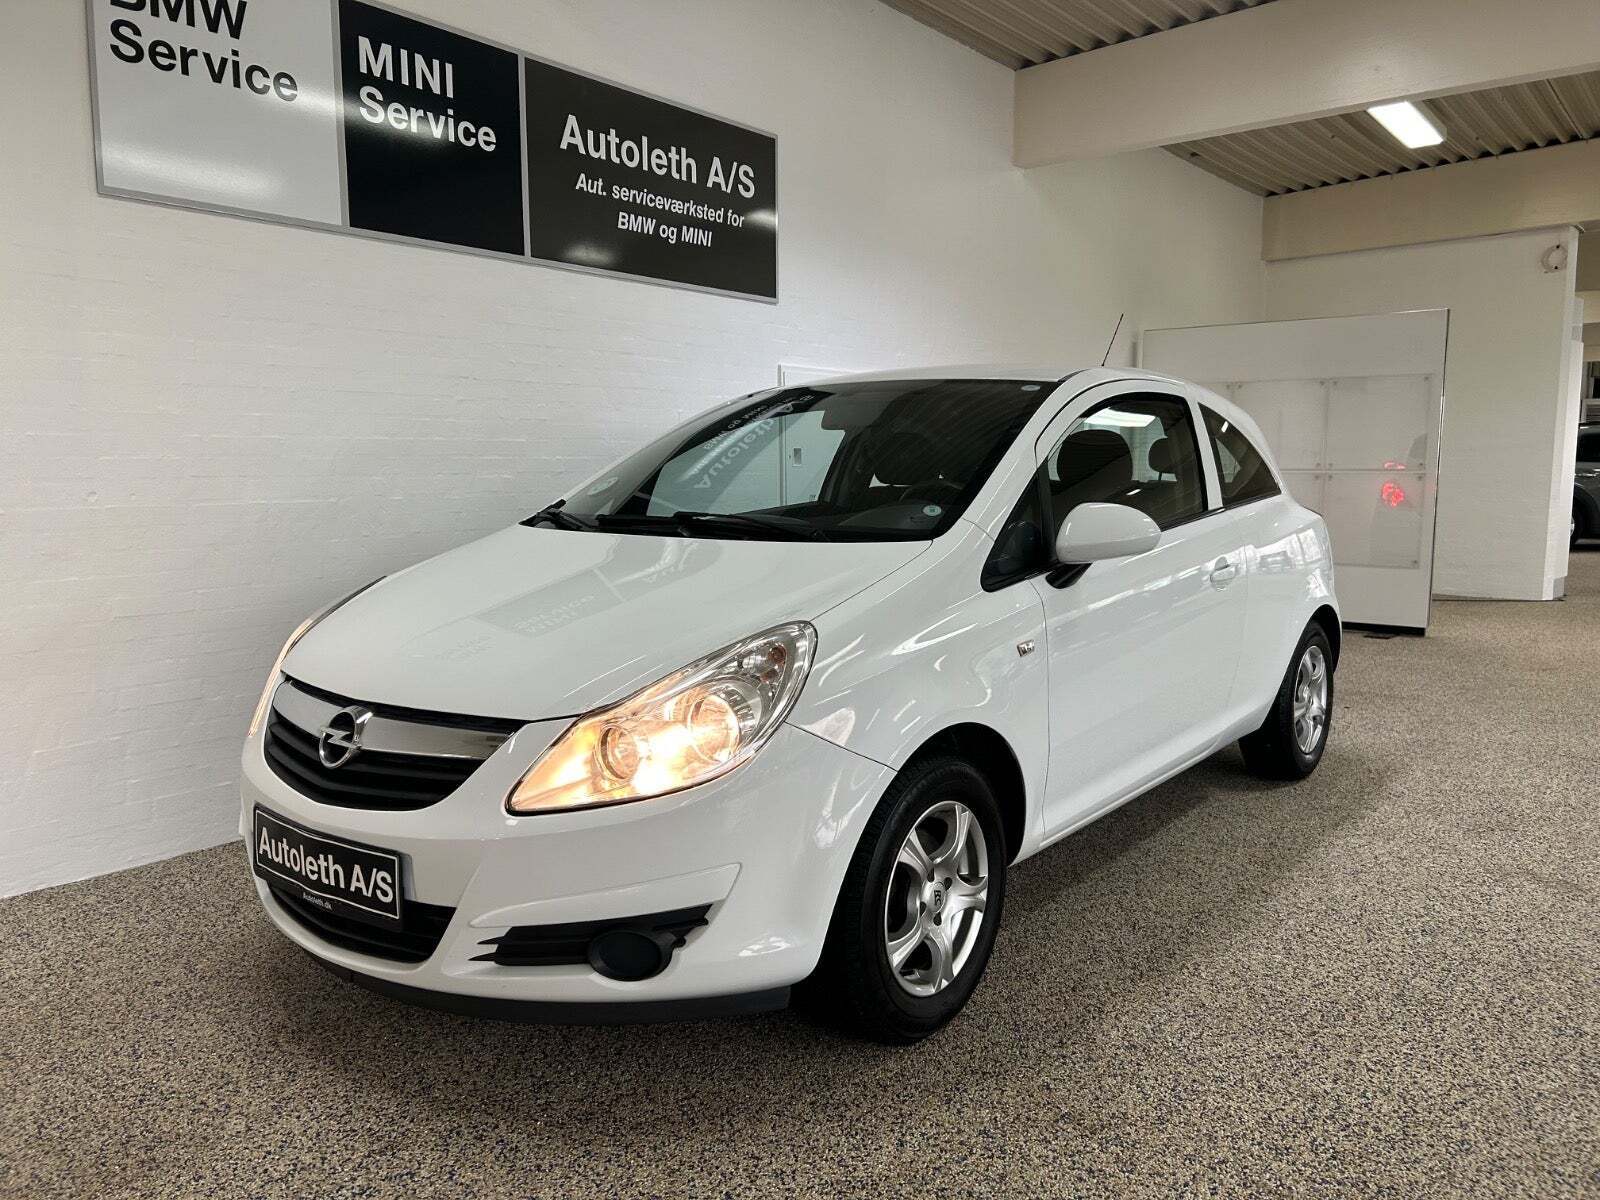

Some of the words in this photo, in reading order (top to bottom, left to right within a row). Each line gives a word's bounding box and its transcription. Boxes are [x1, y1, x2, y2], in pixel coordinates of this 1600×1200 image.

[110, 18, 298, 102] Service
[358, 35, 454, 98] MINI
[359, 85, 497, 152] Service
[559, 113, 697, 184] Autoleth
[706, 156, 755, 199] A/S
[575, 173, 607, 196] Aut.
[612, 184, 724, 224] serviceværksted
[727, 209, 745, 228] for
[617, 211, 656, 235] BMW
[659, 224, 677, 244] og
[681, 225, 713, 248] MINI
[259, 826, 345, 889] Autoleth
[350, 864, 393, 903] A/S
